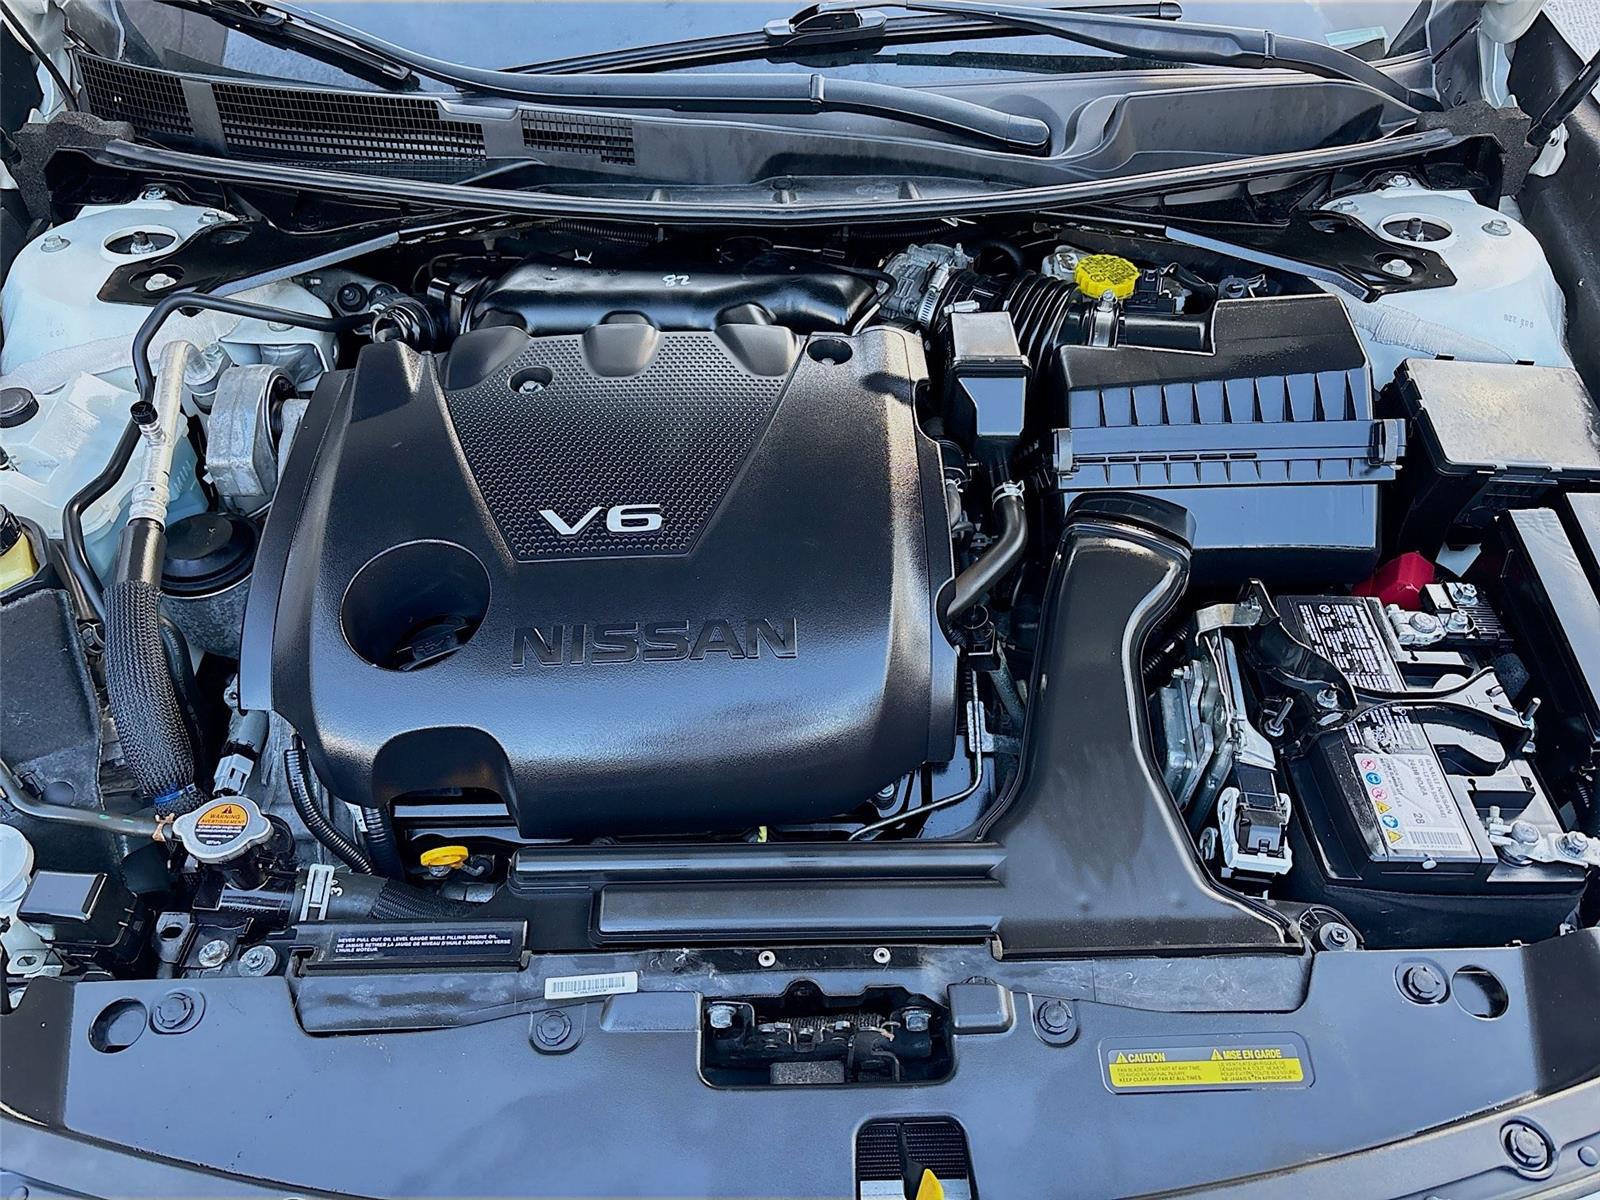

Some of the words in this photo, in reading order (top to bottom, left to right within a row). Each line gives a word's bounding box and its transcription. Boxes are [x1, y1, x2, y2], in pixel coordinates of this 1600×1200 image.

[538, 503, 663, 535] V6
[511, 617, 799, 669] NISSAN
[1412, 812, 1426, 825] 28
[1128, 1052, 1166, 1063] CAUTION
[1223, 1050, 1242, 1060] MISE
[1242, 1049, 1254, 1059] EN
[1254, 1048, 1282, 1059] GARDE
